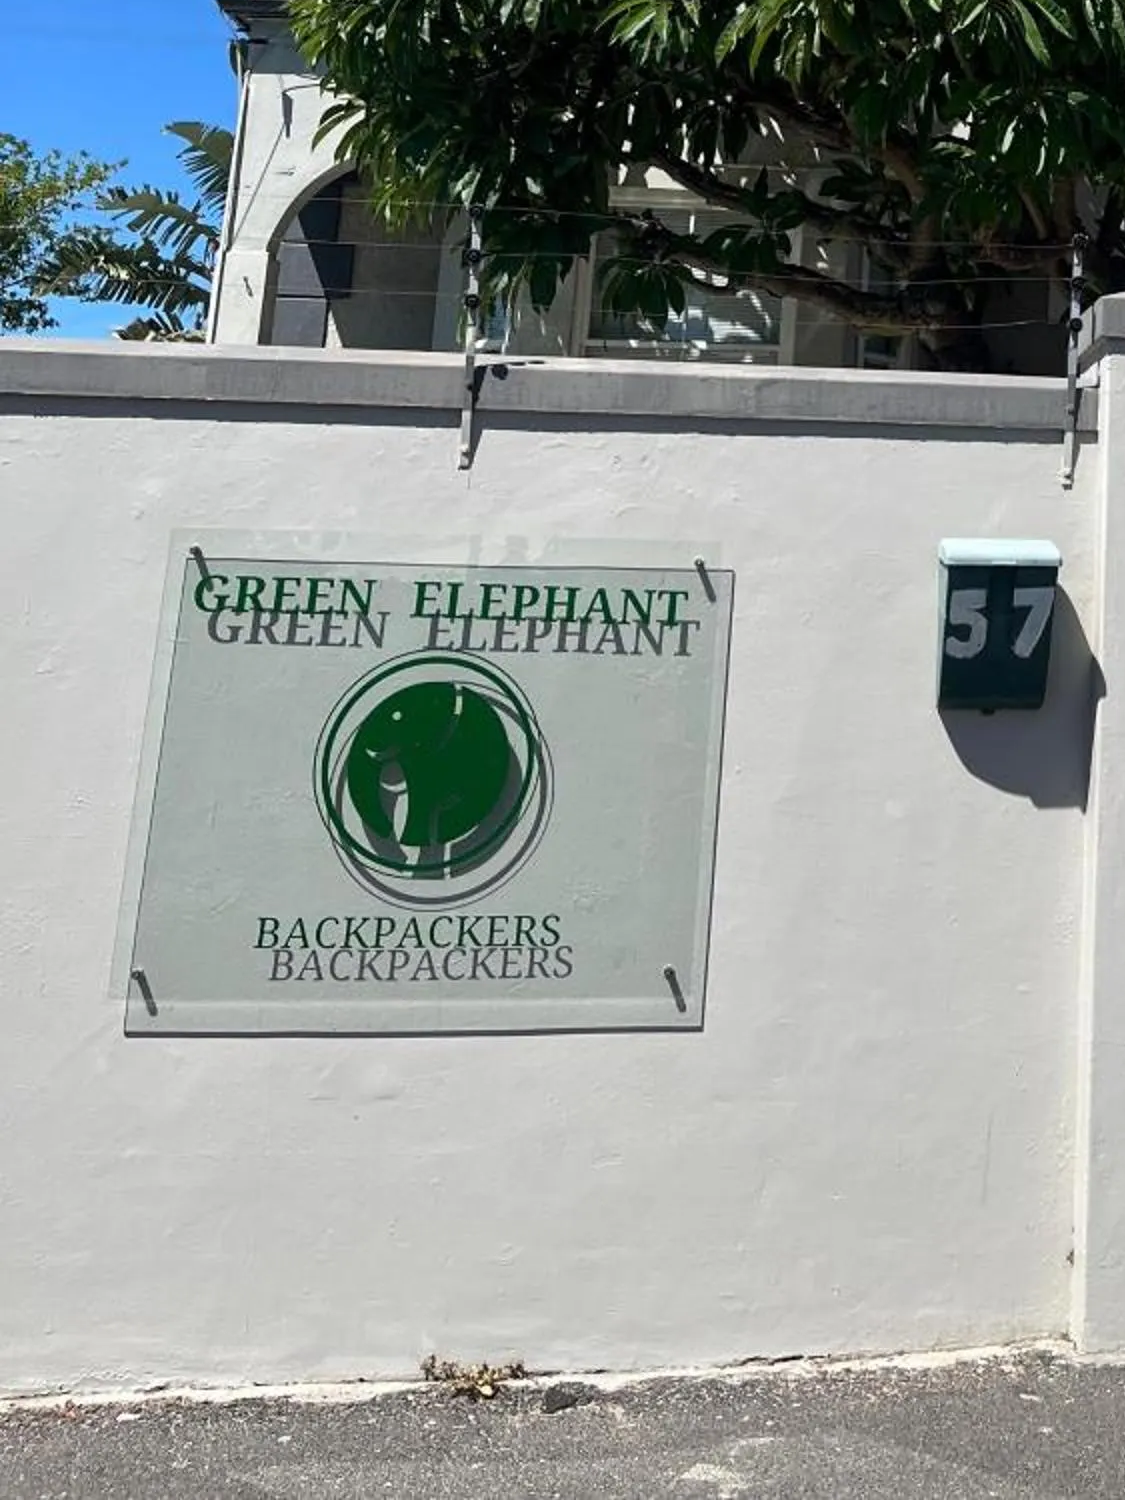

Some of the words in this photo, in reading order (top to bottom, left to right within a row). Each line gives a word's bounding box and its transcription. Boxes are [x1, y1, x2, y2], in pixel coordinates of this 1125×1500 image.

[194, 575, 378, 616] GREEN
[410, 581, 689, 627] ELEPHANT
[945, 586, 1055, 659] 57
[254, 913, 561, 950] BACKPACKERS
